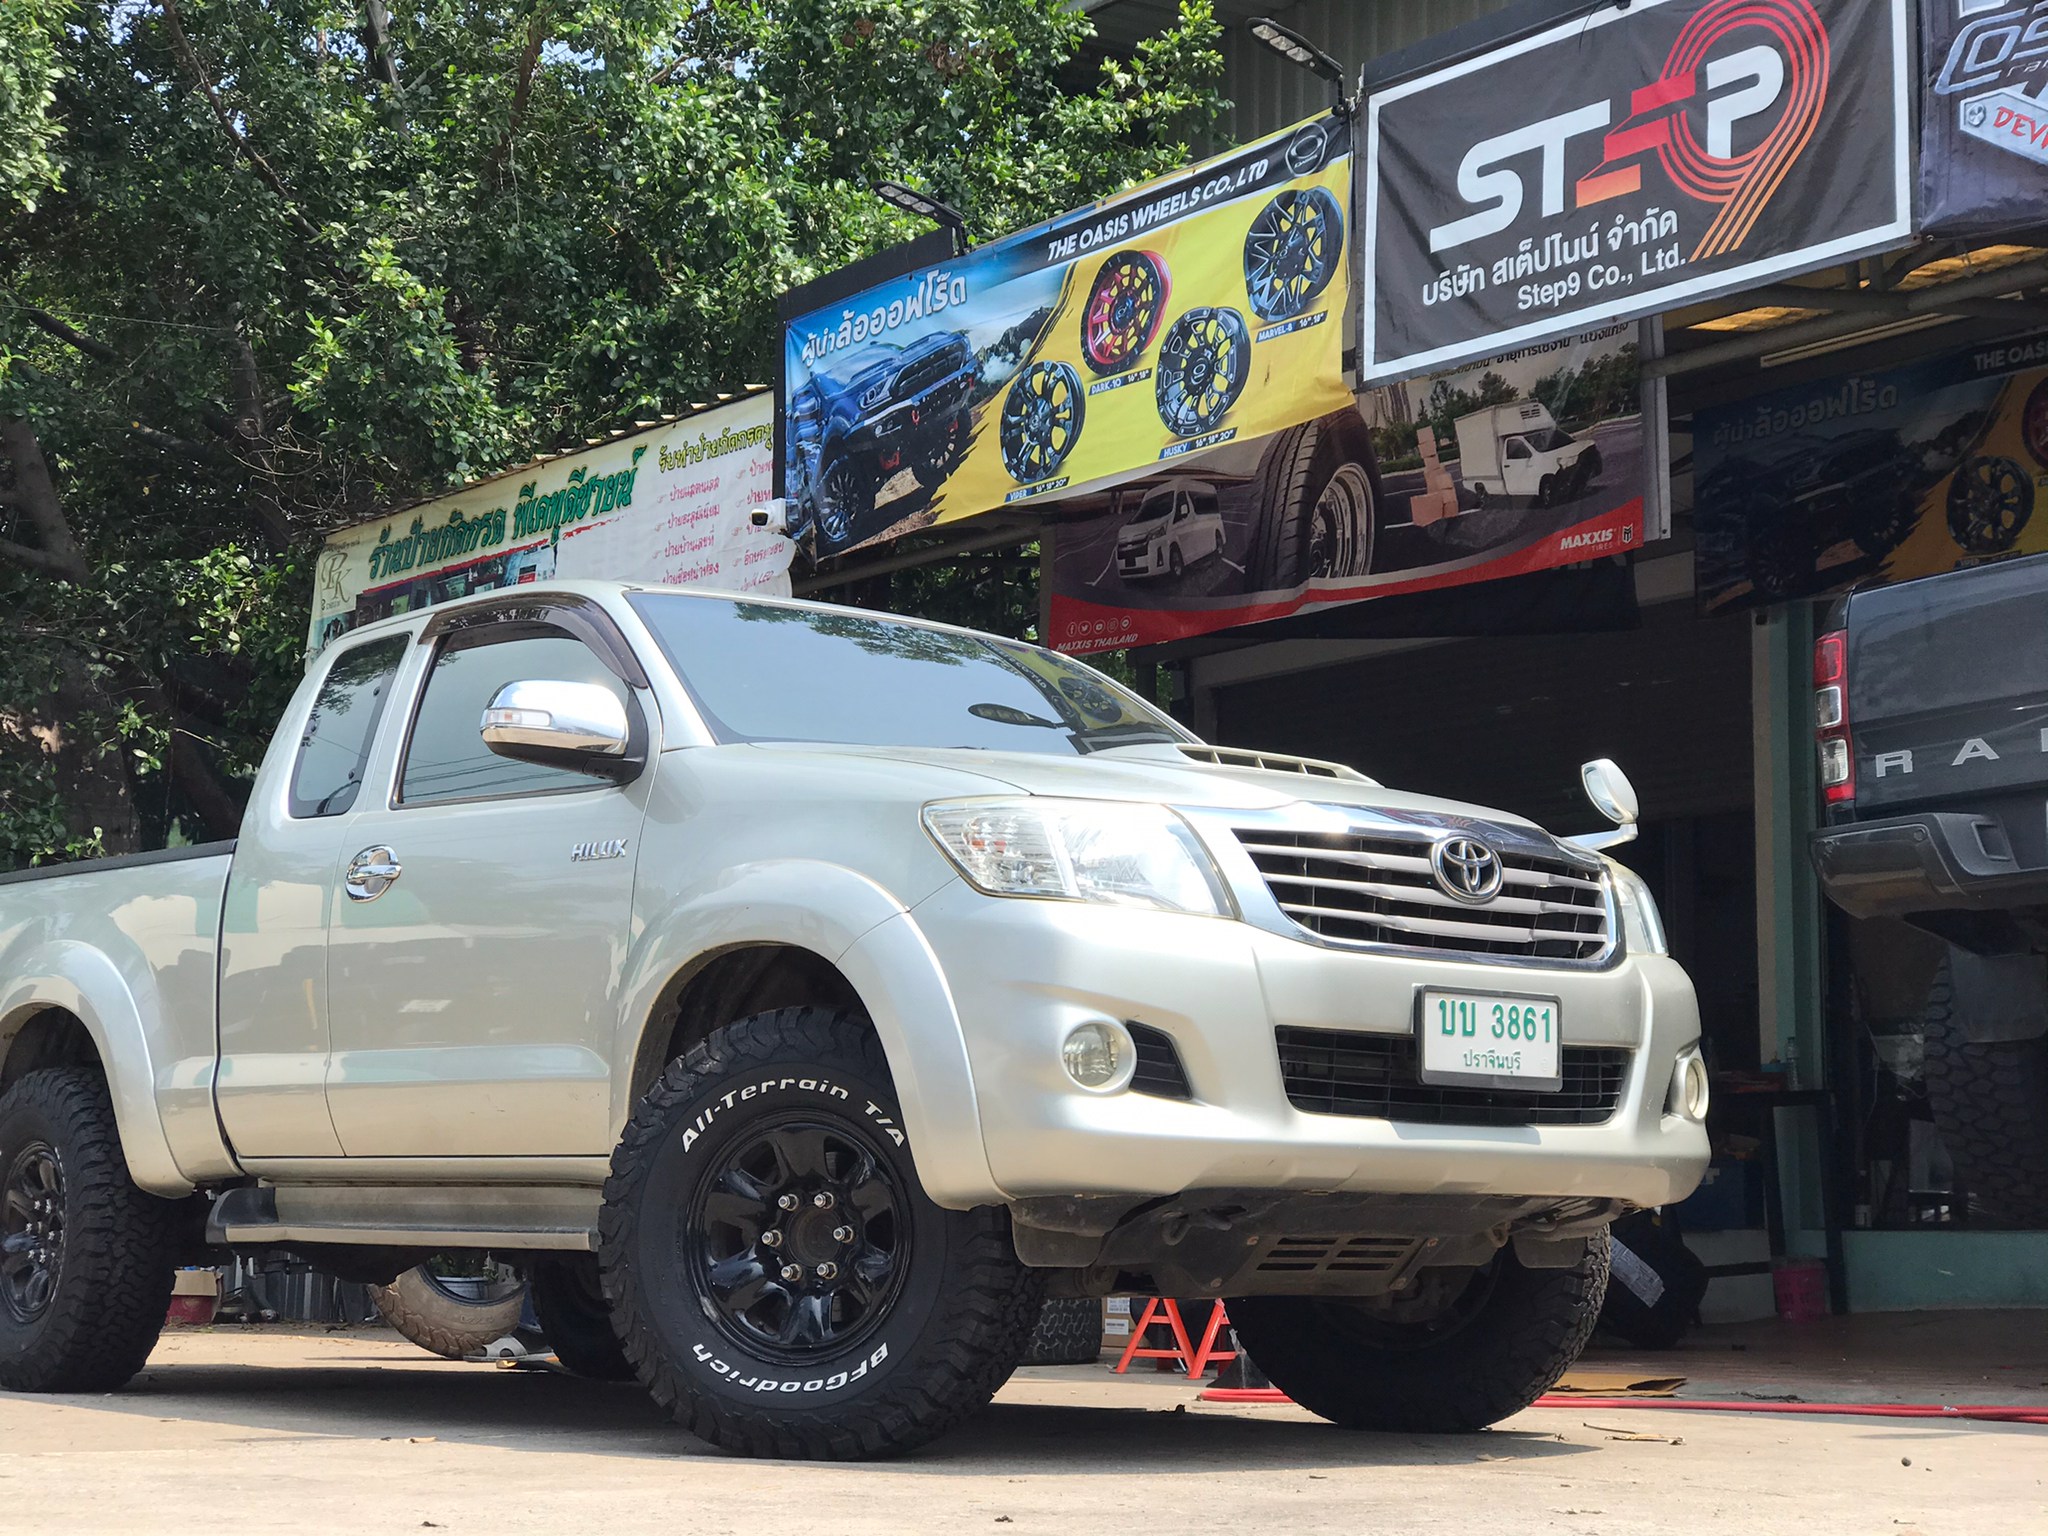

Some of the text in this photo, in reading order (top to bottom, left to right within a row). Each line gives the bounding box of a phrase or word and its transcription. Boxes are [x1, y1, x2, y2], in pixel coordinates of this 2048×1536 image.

[1047, 232, 1079, 262] THE
[1079, 215, 1129, 250] OASIS
[1132, 186, 1202, 230] WHEELS
[1422, 206, 1678, 306] บริษัท สเต็ปไนน์ จำกัด
[1517, 243, 1687, 310] Step9 Co., Ltd.
[1974, 350, 2006, 371] THE
[1163, 442, 1188, 458] HUSKY
[1560, 528, 1614, 550] MAXXIS
[1591, 542, 1613, 551] TIRES
[1056, 633, 1138, 652] MAXXIS THAILAND
[1875, 727, 2048, 778] RA
[571, 839, 628, 861] HILUX
[1439, 999, 1551, 1042] บบ 3861
[1463, 1049, 1521, 1074] ปราจีนบุรี
[681, 1077, 850, 1153] All-Terrain
[692, 1342, 889, 1392] BFGoodrich
